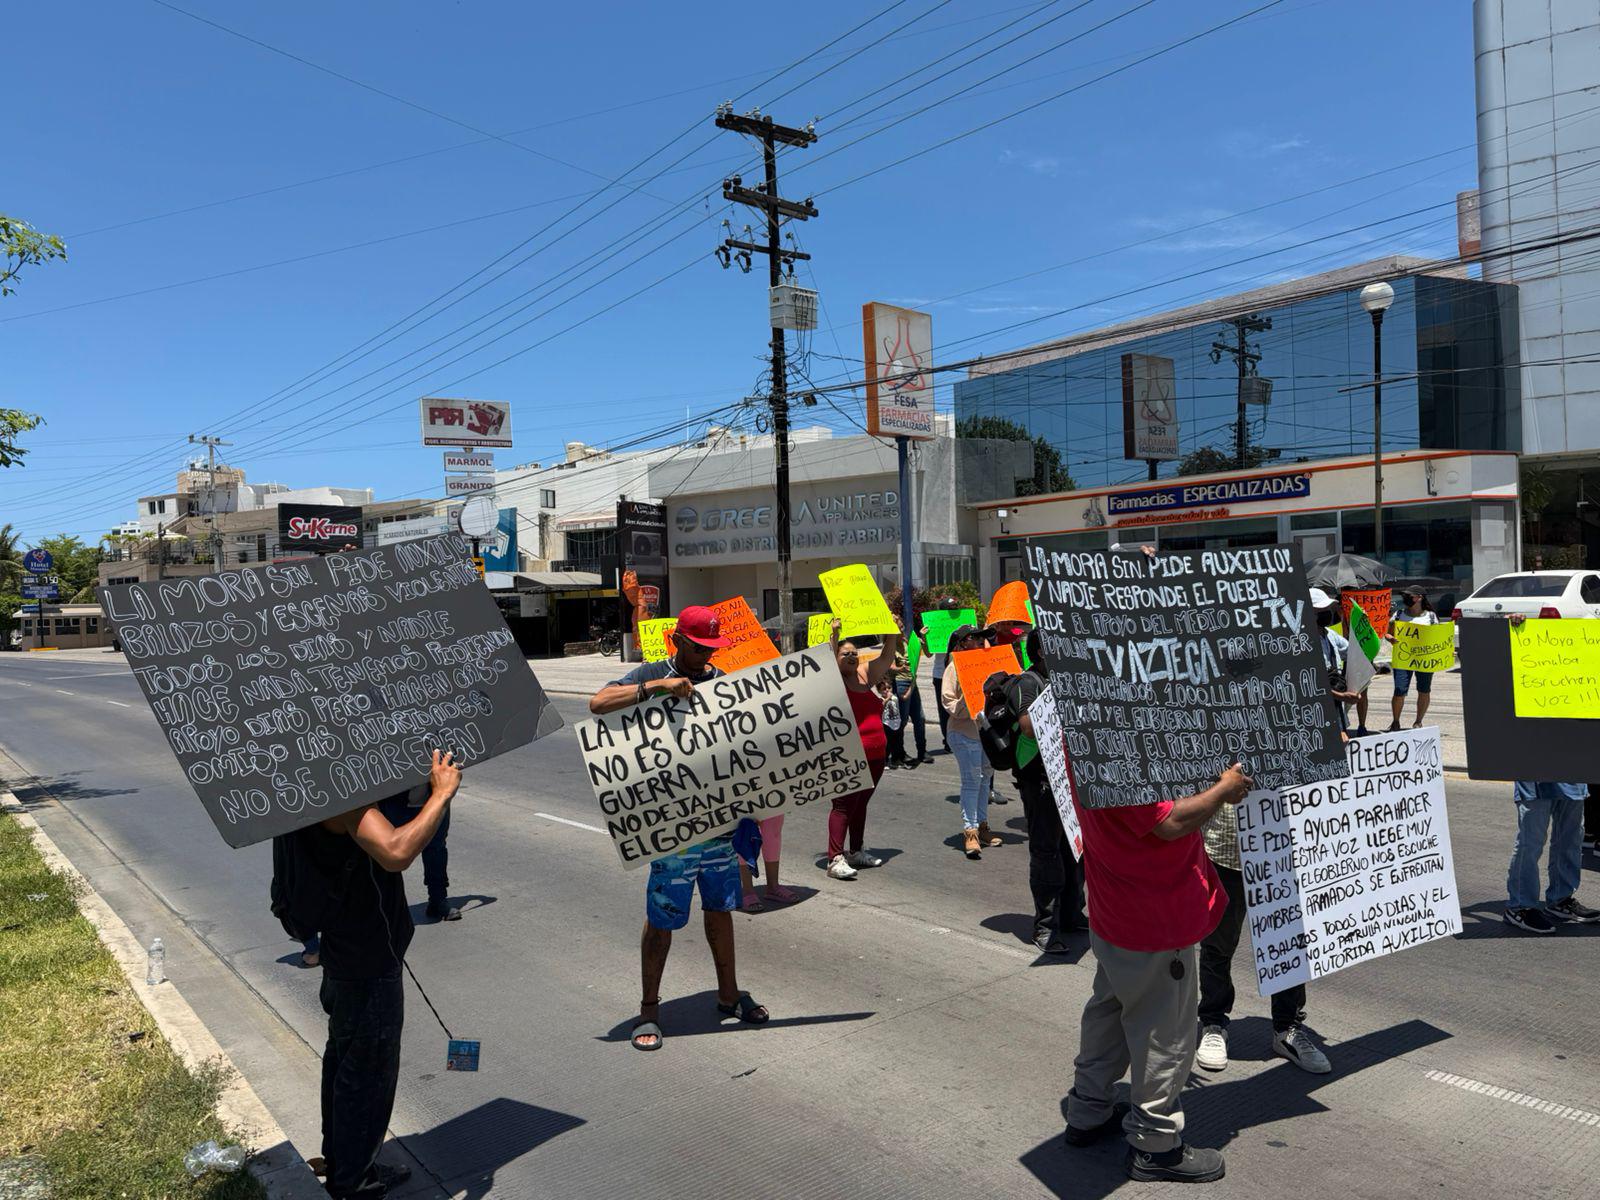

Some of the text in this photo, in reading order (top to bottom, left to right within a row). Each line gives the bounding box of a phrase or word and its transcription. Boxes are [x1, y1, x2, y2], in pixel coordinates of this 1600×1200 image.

[894, 394, 918, 409] FESA
[881, 418, 931, 432] ESPECIALIZADAS
[447, 458, 492, 466] MARMOL
[449, 482, 493, 490] GRANITO
[817, 491, 898, 511] UNITED
[1109, 475, 1306, 511] Farmacias ESPECIALIZADAS
[287, 516, 358, 539] SuKarne
[701, 506, 772, 531] GREE
[819, 508, 900, 524] APPLIANCES
[675, 539, 727, 556] CENTRO
[1148, 555, 1194, 579] PIDE
[1201, 548, 1294, 576] AUXILIO!
[104, 584, 156, 621] LA
[159, 567, 265, 616] MORA
[325, 551, 393, 587] PIDE
[394, 534, 467, 573] AUXILIO
[1031, 577, 1043, 600] Y
[1047, 579, 1101, 610] NADIE
[1192, 581, 1215, 606] EL
[1216, 576, 1279, 604] PUEBLO
[119, 586, 387, 659] BALAZOS Y ESCENAS
[1035, 604, 1067, 632] PIDE
[1071, 612, 1090, 635] EL
[1091, 612, 1137, 637] APOYO
[1140, 613, 1173, 635] DEL
[1173, 608, 1230, 635] MEDIO
[1234, 604, 1262, 628] DE
[1396, 626, 1420, 640] Y LA
[134, 609, 455, 694] TODOS LOS DIAS Y NADIE
[1216, 633, 1259, 660] PARA
[1258, 632, 1313, 656] PODER
[153, 684, 240, 724] HACE
[307, 644, 428, 693] TENEMOS
[425, 627, 515, 665] PIDIENDO
[1300, 667, 1327, 698] AL
[169, 723, 240, 754] APOYO
[244, 700, 311, 737] DIAS
[311, 693, 371, 726] PERO
[453, 659, 509, 688] CASO
[580, 653, 821, 752] LA MORA SINALOA
[1113, 705, 1130, 728] EL
[189, 690, 493, 784] OMISO LAS AUTORIDADES
[588, 692, 799, 786] NO ES CAMPO DE
[711, 739, 766, 781] LAS
[775, 706, 852, 757] BALAS
[1142, 732, 1166, 760] EL
[1164, 732, 1224, 760] PUEBLO
[1225, 730, 1256, 753] DE
[1256, 727, 1277, 750] LA
[1278, 729, 1324, 753] MORA
[219, 722, 485, 823] NO SE APARECEN
[1072, 760, 1097, 787] NO
[1263, 751, 1315, 771] HOGAR
[1349, 739, 1409, 774] PLIEGO
[608, 746, 849, 840] NO DEJAN DE LLOVER
[793, 776, 862, 806] SOLOS
[1236, 804, 1256, 832] EL
[1258, 788, 1322, 826] PUEBLO
[1327, 781, 1351, 804] DE
[1355, 778, 1375, 798] LA
[1377, 769, 1423, 794] MORA
[619, 759, 867, 862] EL GOBIERNO NOS DEJO
[1240, 792, 1433, 853] LE PIDE AYUDA PARA HACER
[1243, 860, 1273, 885] QUE
[1275, 843, 1329, 874] NUESTRA
[1331, 837, 1361, 858] VOZ
[1407, 816, 1433, 838] MUY
[1247, 834, 1440, 908] LEJOS Y EL GOBIERNO NOS ESCUCHE
[1251, 856, 1444, 938] HOMBRES ARMADOS SE ENFRENTAN
[1256, 886, 1451, 963] A BALAZOS TODOS LOS DIAS Y EL
[1258, 908, 1435, 984] PUEBLO NO LO PATRULLA NINGUNA
[1313, 940, 1376, 977] AUTORIDA
